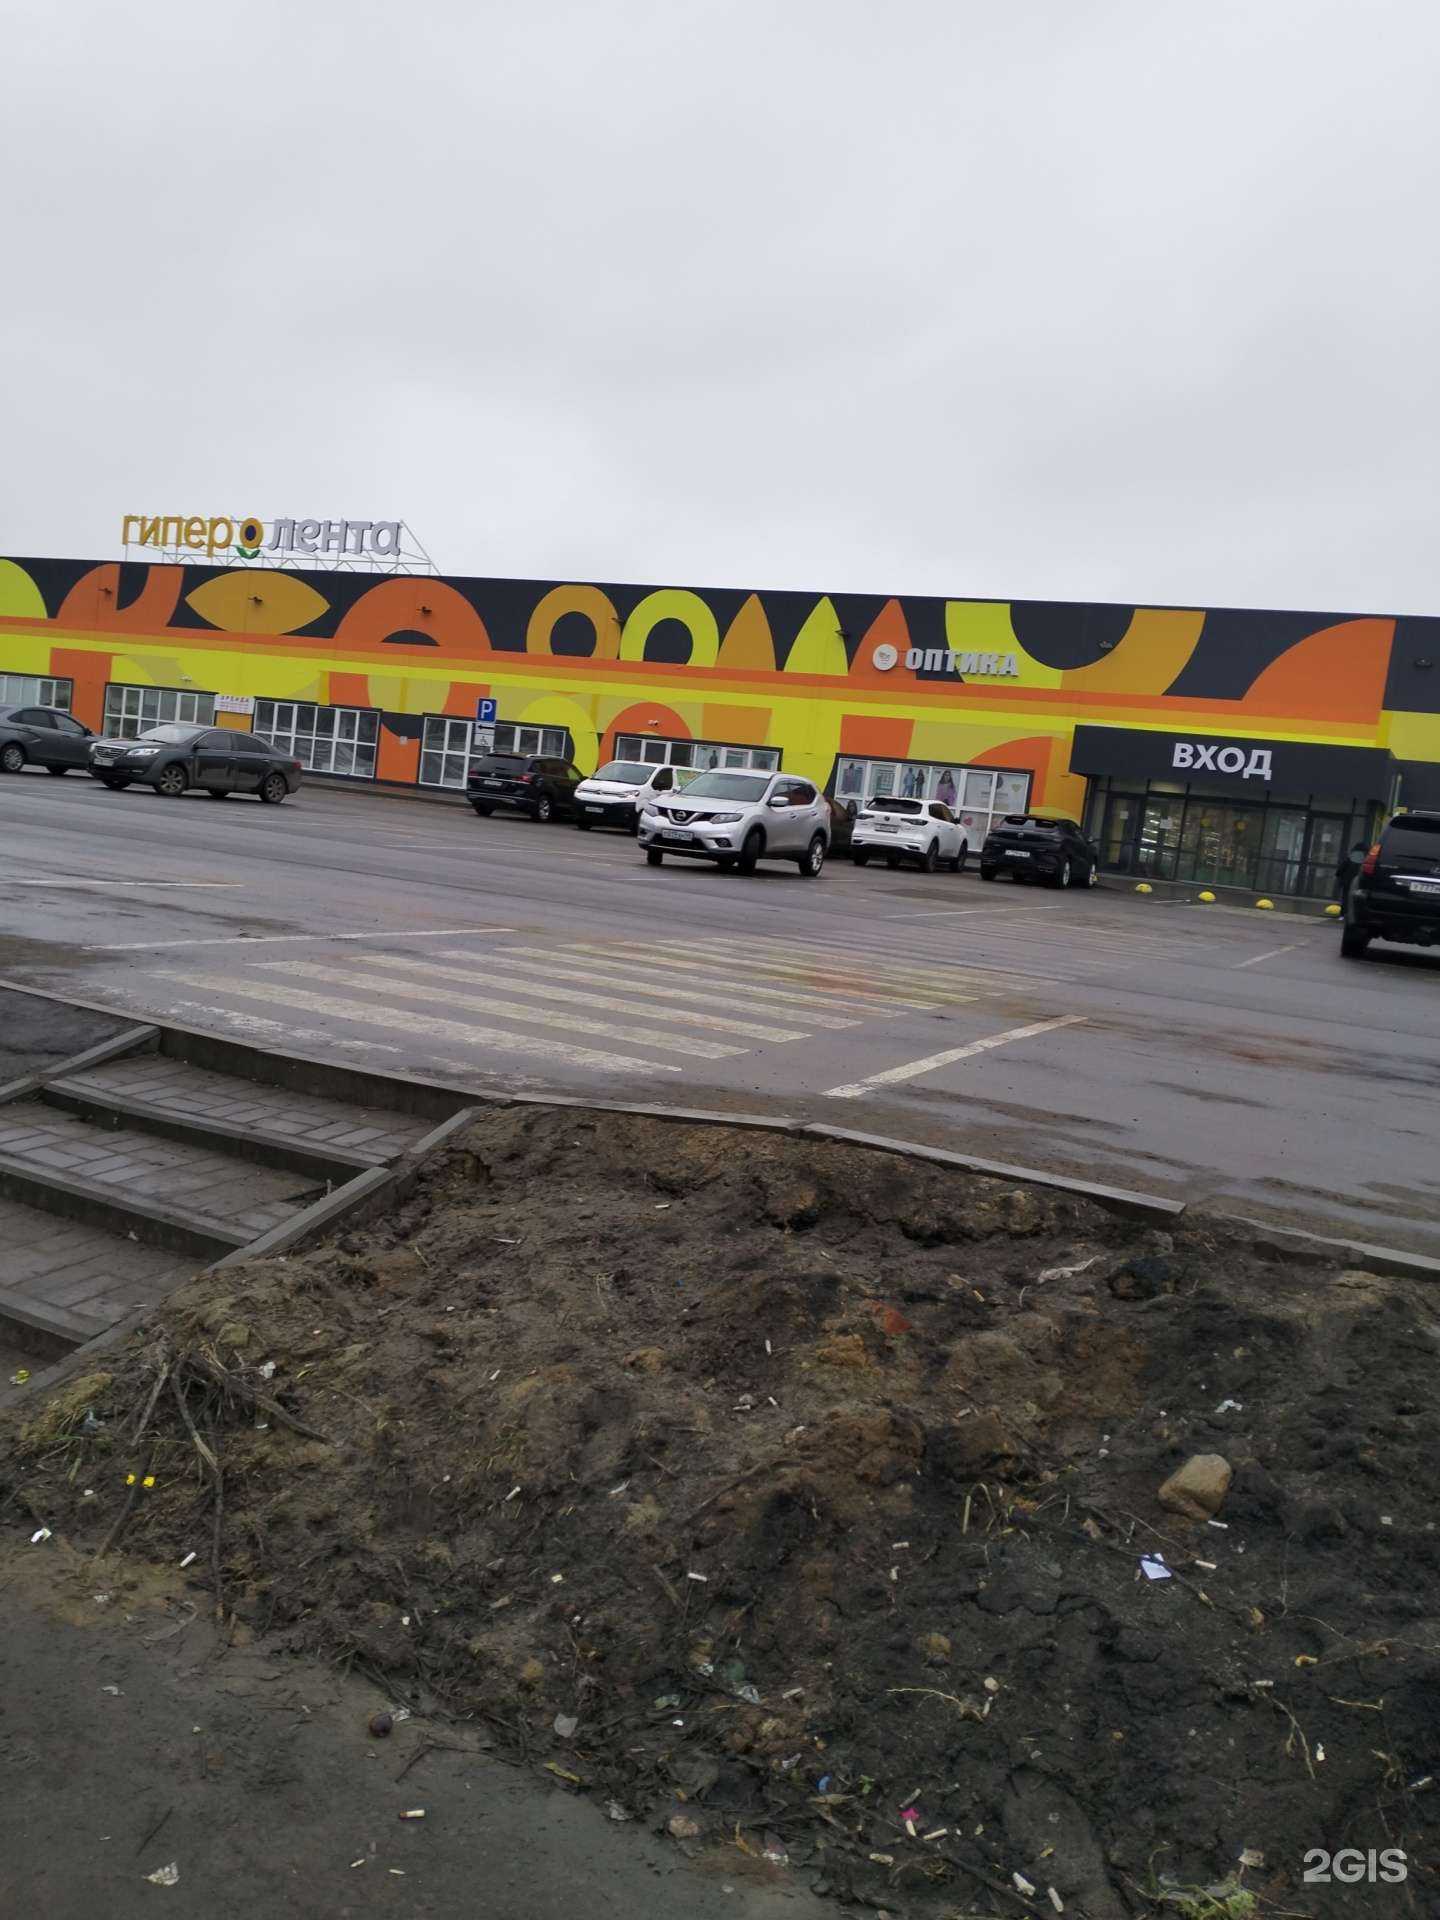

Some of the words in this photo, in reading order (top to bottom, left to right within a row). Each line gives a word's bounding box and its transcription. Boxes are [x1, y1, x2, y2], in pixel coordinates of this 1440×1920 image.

[268, 518, 402, 555] лента
[905, 647, 1020, 678] ОПТИКА
[1172, 742, 1273, 781] ВХОД
